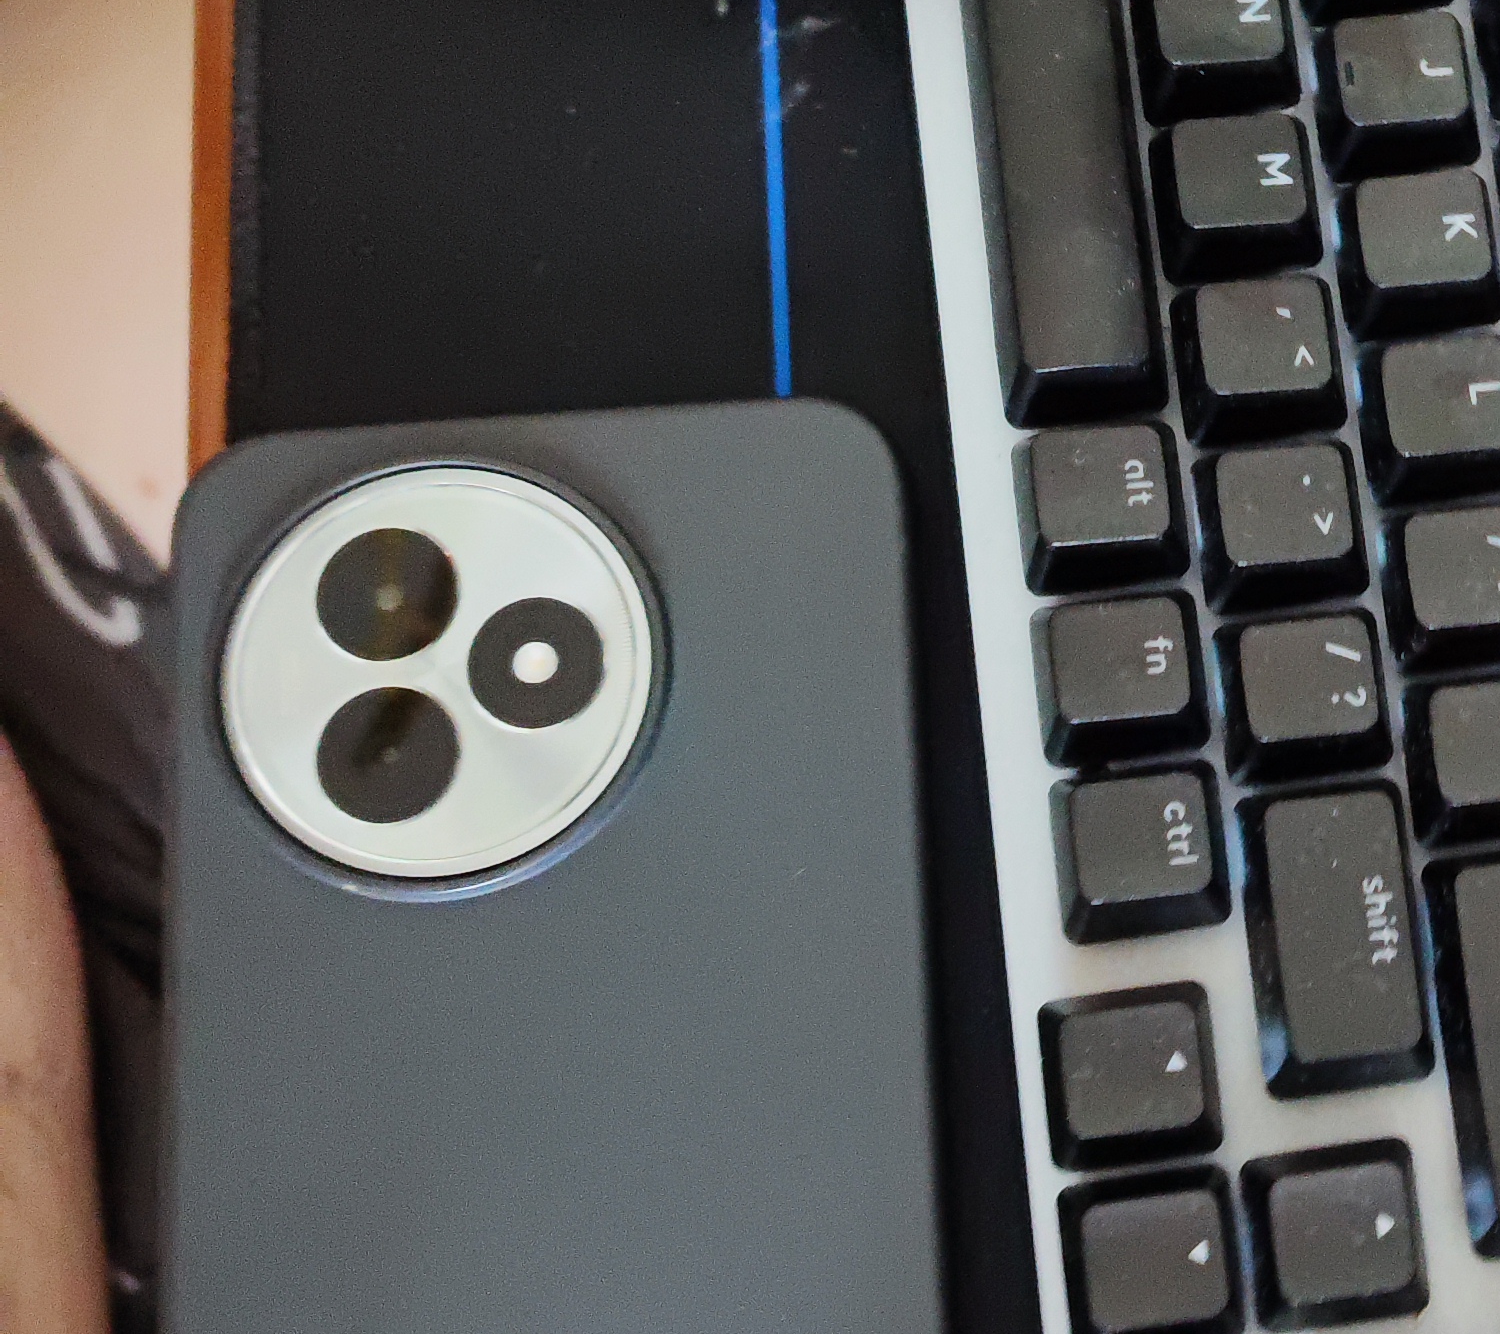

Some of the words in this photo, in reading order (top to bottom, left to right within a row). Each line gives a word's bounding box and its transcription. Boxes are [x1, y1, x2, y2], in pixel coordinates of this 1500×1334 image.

[1419, 58, 1455, 78] J
[1257, 152, 1294, 186] M
[1442, 213, 1478, 242] K
[1124, 459, 1154, 507] alt
[1144, 635, 1174, 675] fn
[1331, 685, 1367, 708] ?
[1163, 800, 1200, 866] ctrl
[1362, 875, 1400, 965] shift
